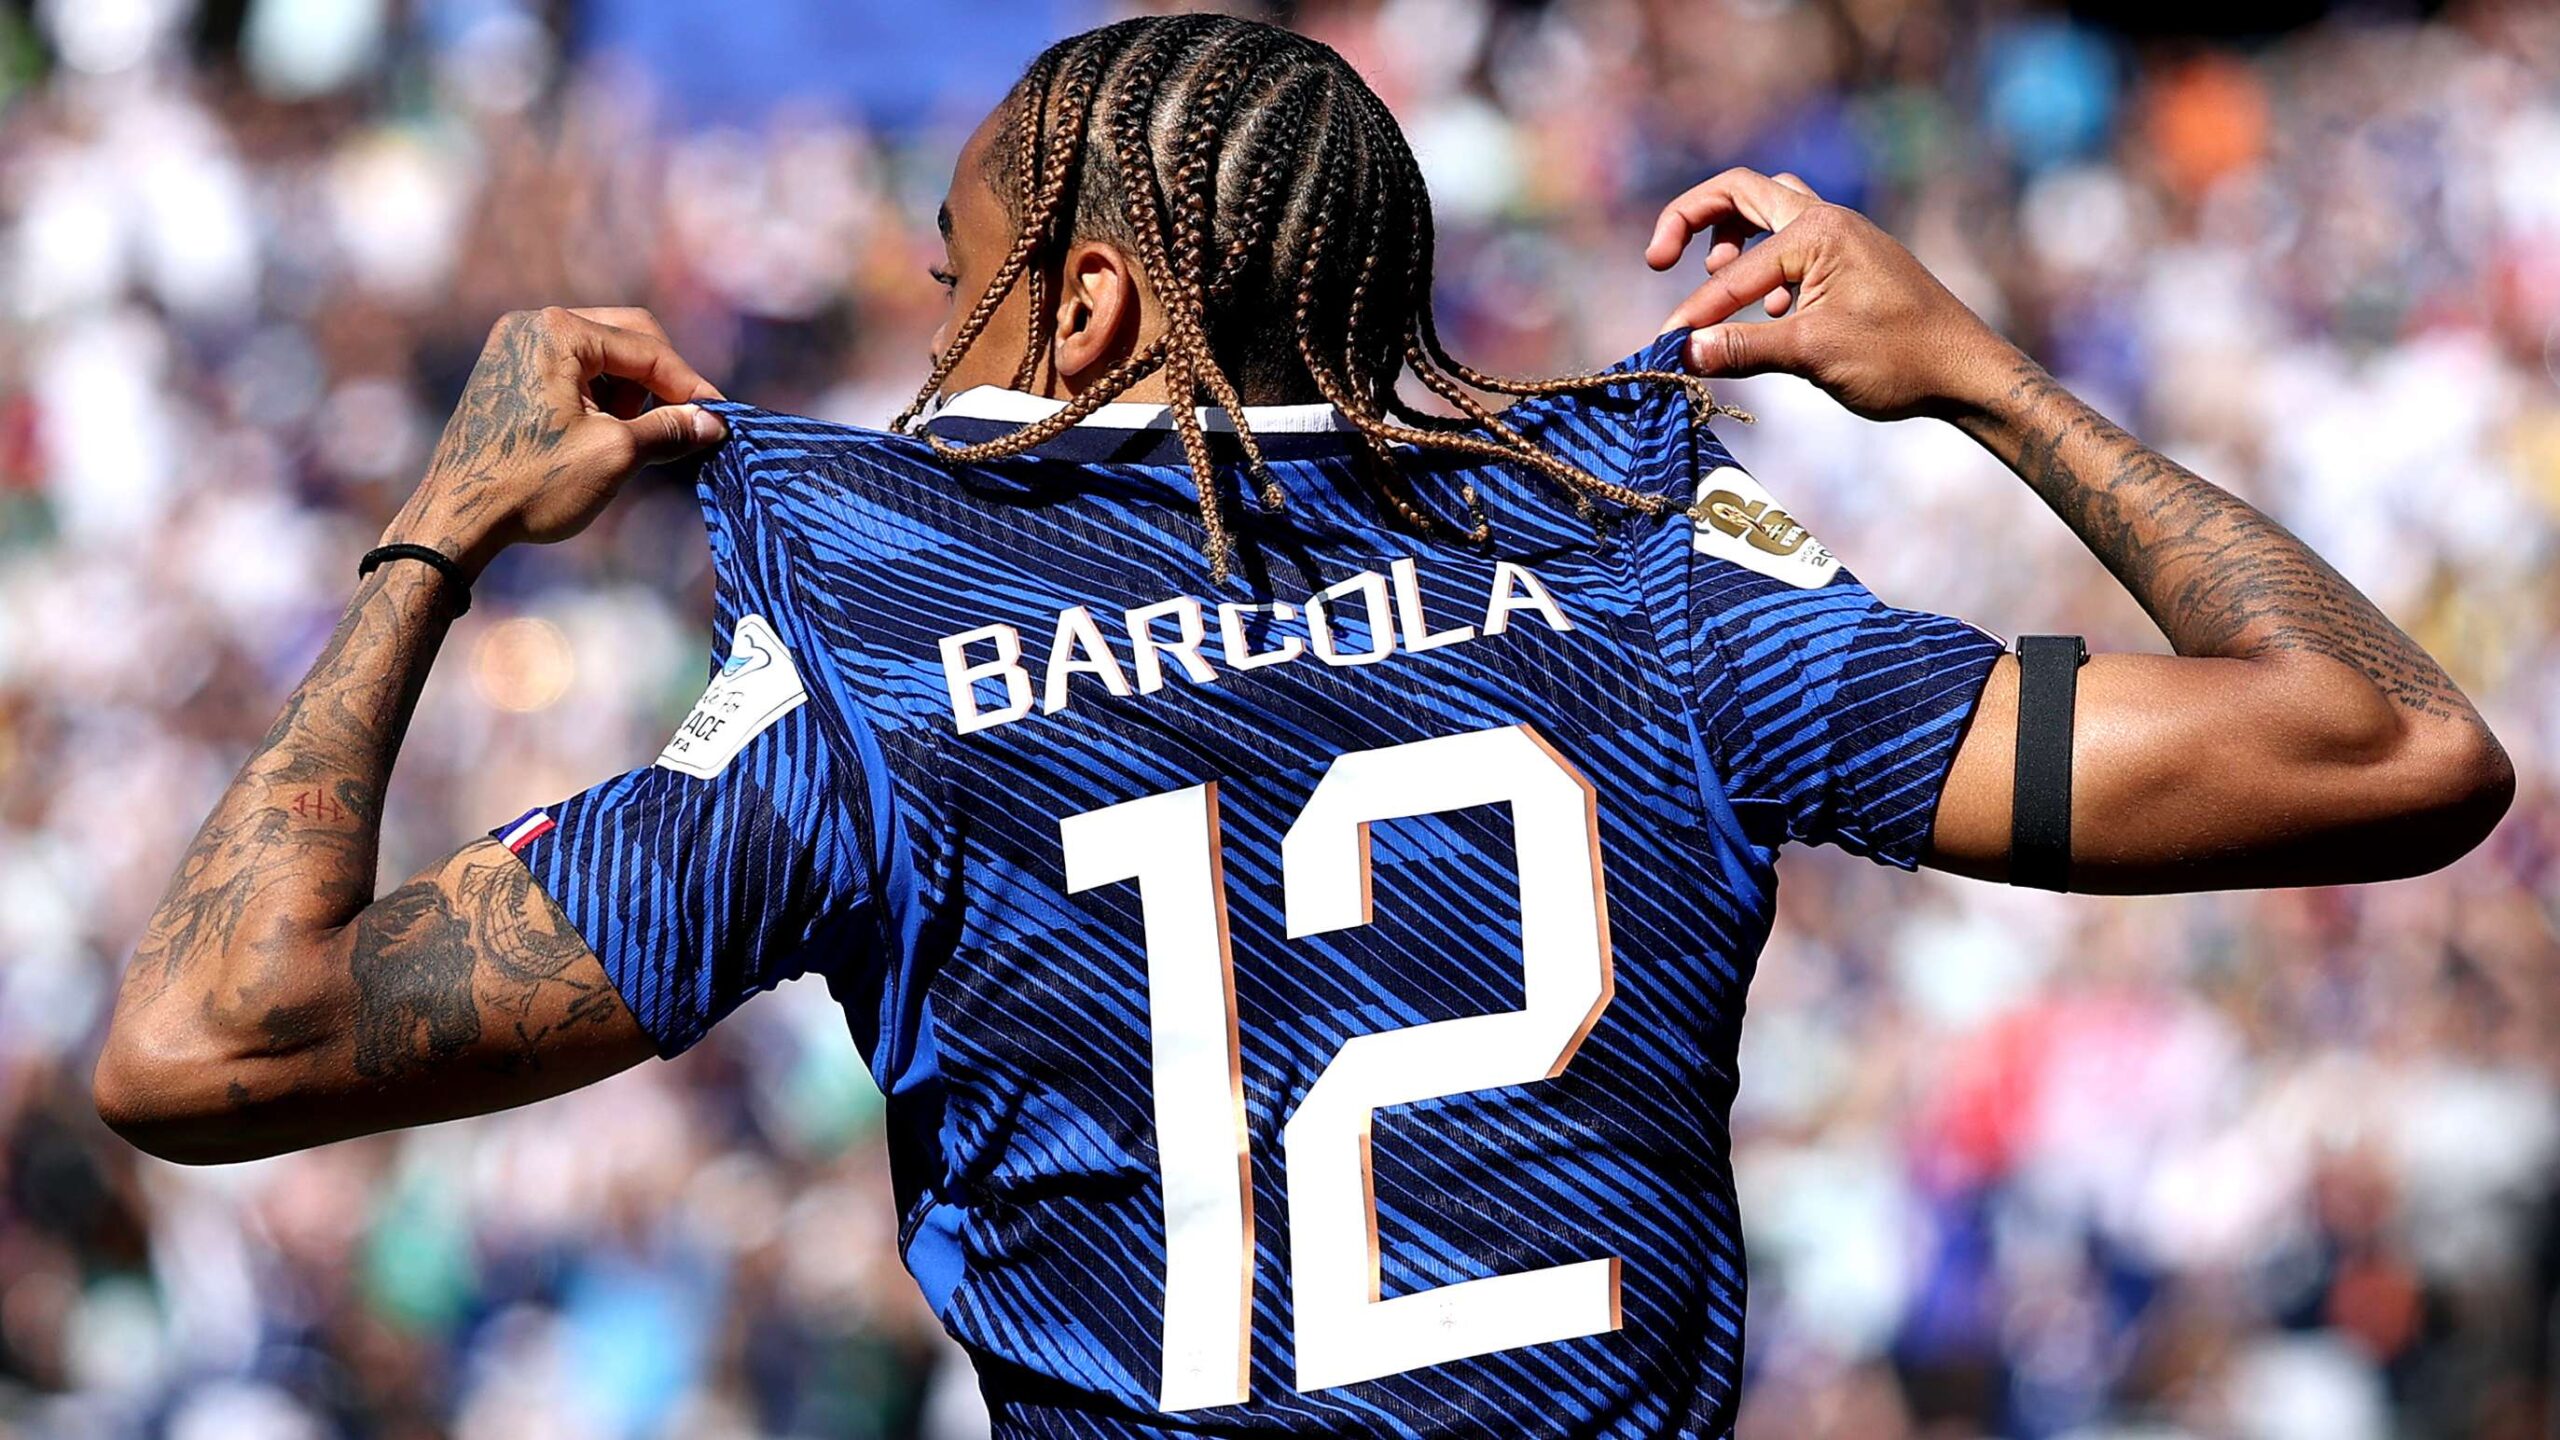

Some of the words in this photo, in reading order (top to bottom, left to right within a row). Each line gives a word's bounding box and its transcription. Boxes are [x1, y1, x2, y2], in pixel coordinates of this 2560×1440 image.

[938, 557, 1575, 735] BARCOLA
[672, 736, 691, 753] FA
[683, 711, 725, 741] ACE
[1059, 723, 1623, 1412] 12
